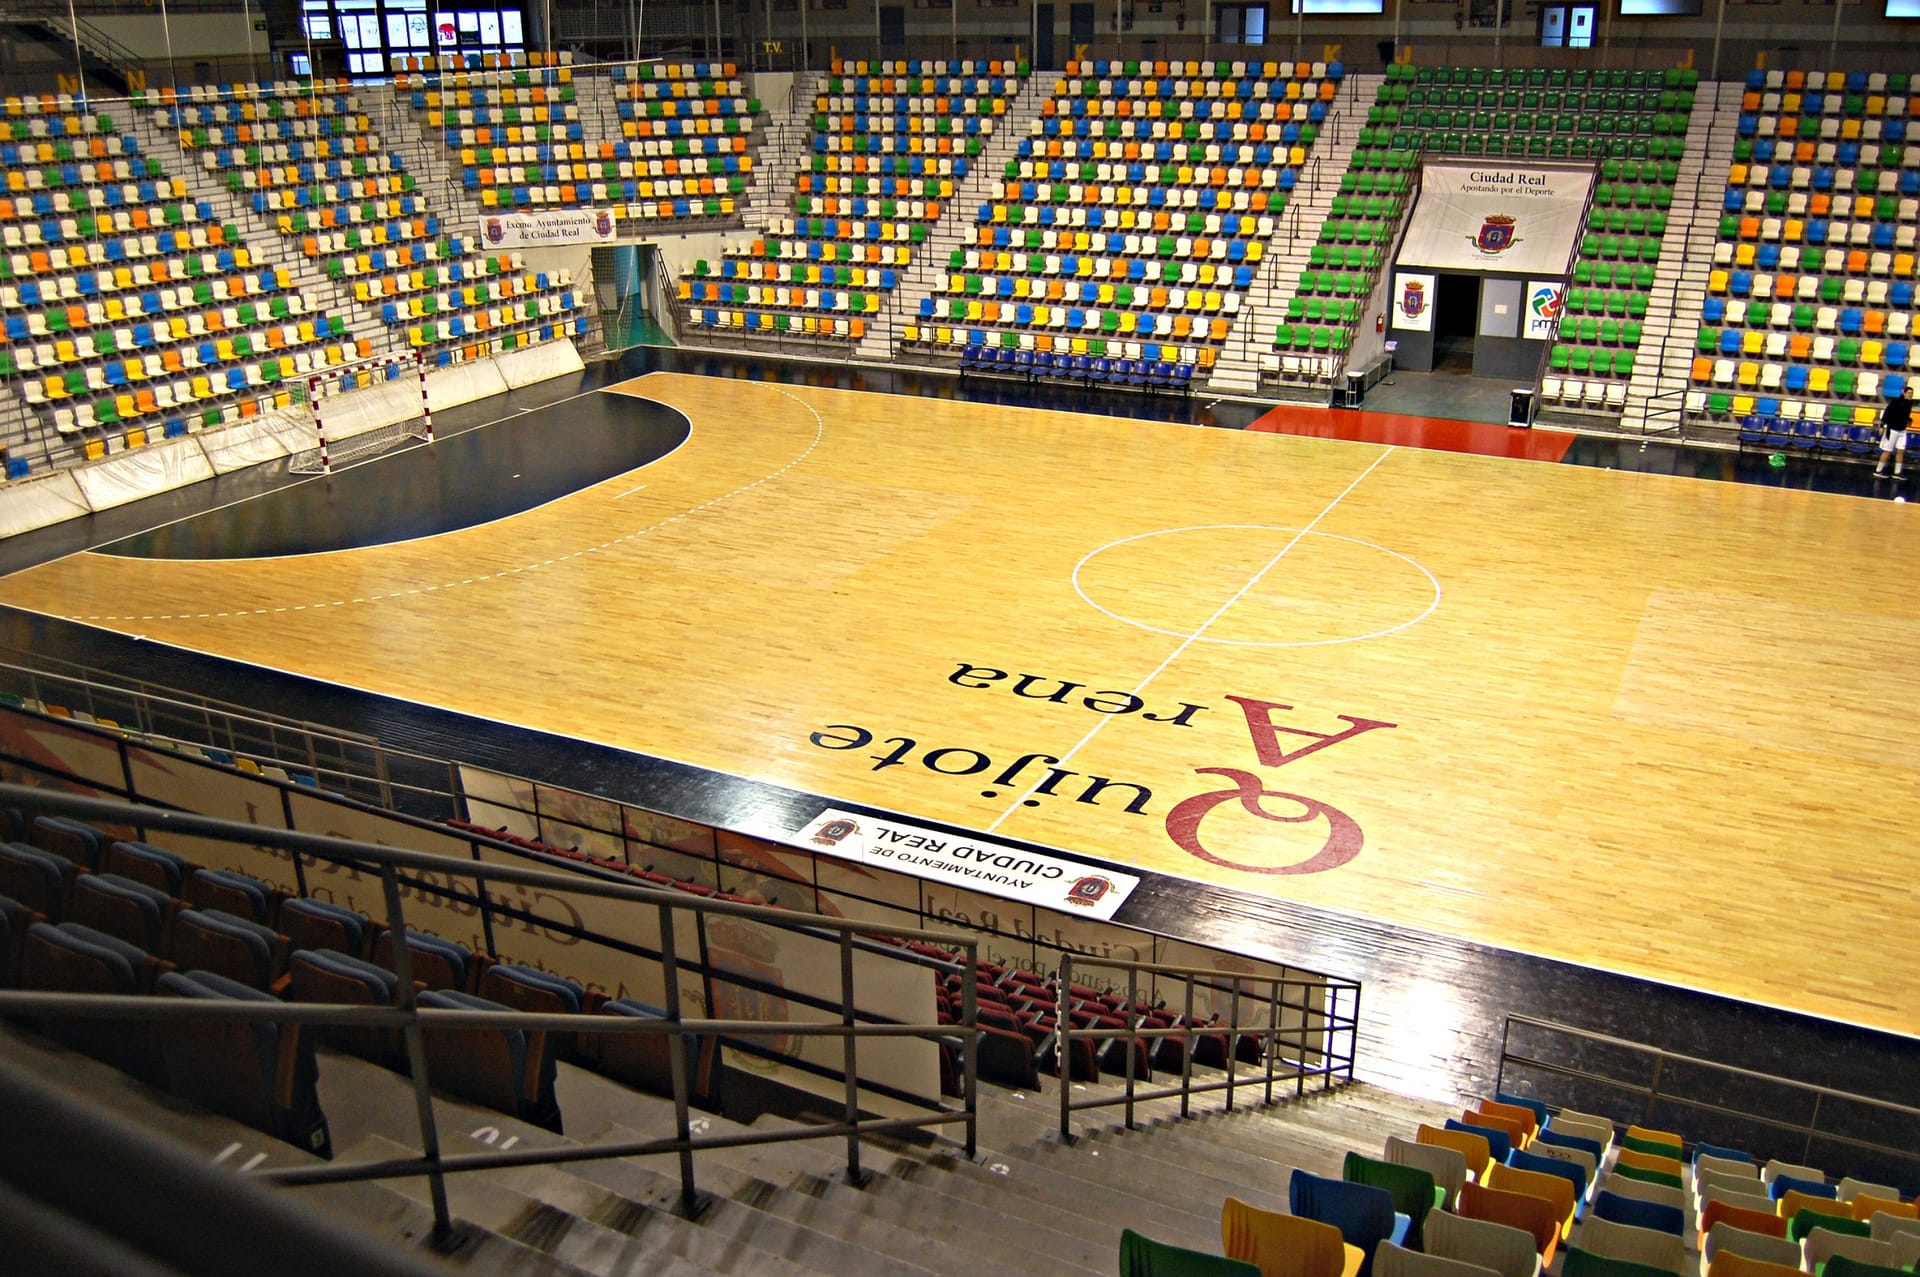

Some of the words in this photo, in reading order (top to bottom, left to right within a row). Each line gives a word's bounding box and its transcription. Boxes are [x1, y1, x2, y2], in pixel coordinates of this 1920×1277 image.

[1075, 43, 1089, 62] K
[1323, 43, 1341, 63] K
[57, 73, 78, 94] N
[127, 70, 146, 90] N
[1470, 171, 1514, 184] Ciudad
[1518, 174, 1546, 186] Real
[1460, 184, 1499, 194] Apostando
[1500, 187, 1514, 195] por
[1525, 187, 1555, 197] Deporte
[536, 217, 591, 229] Ayuntamiento
[519, 232, 530, 240] de
[531, 230, 560, 240] Ciudad
[562, 228, 580, 237] Real
[876, 826, 948, 853] REAL
[869, 846, 896, 858] DE
[898, 853, 1033, 889] AYUNTAMIENTO
[952, 845, 1064, 880] CIUDAD
